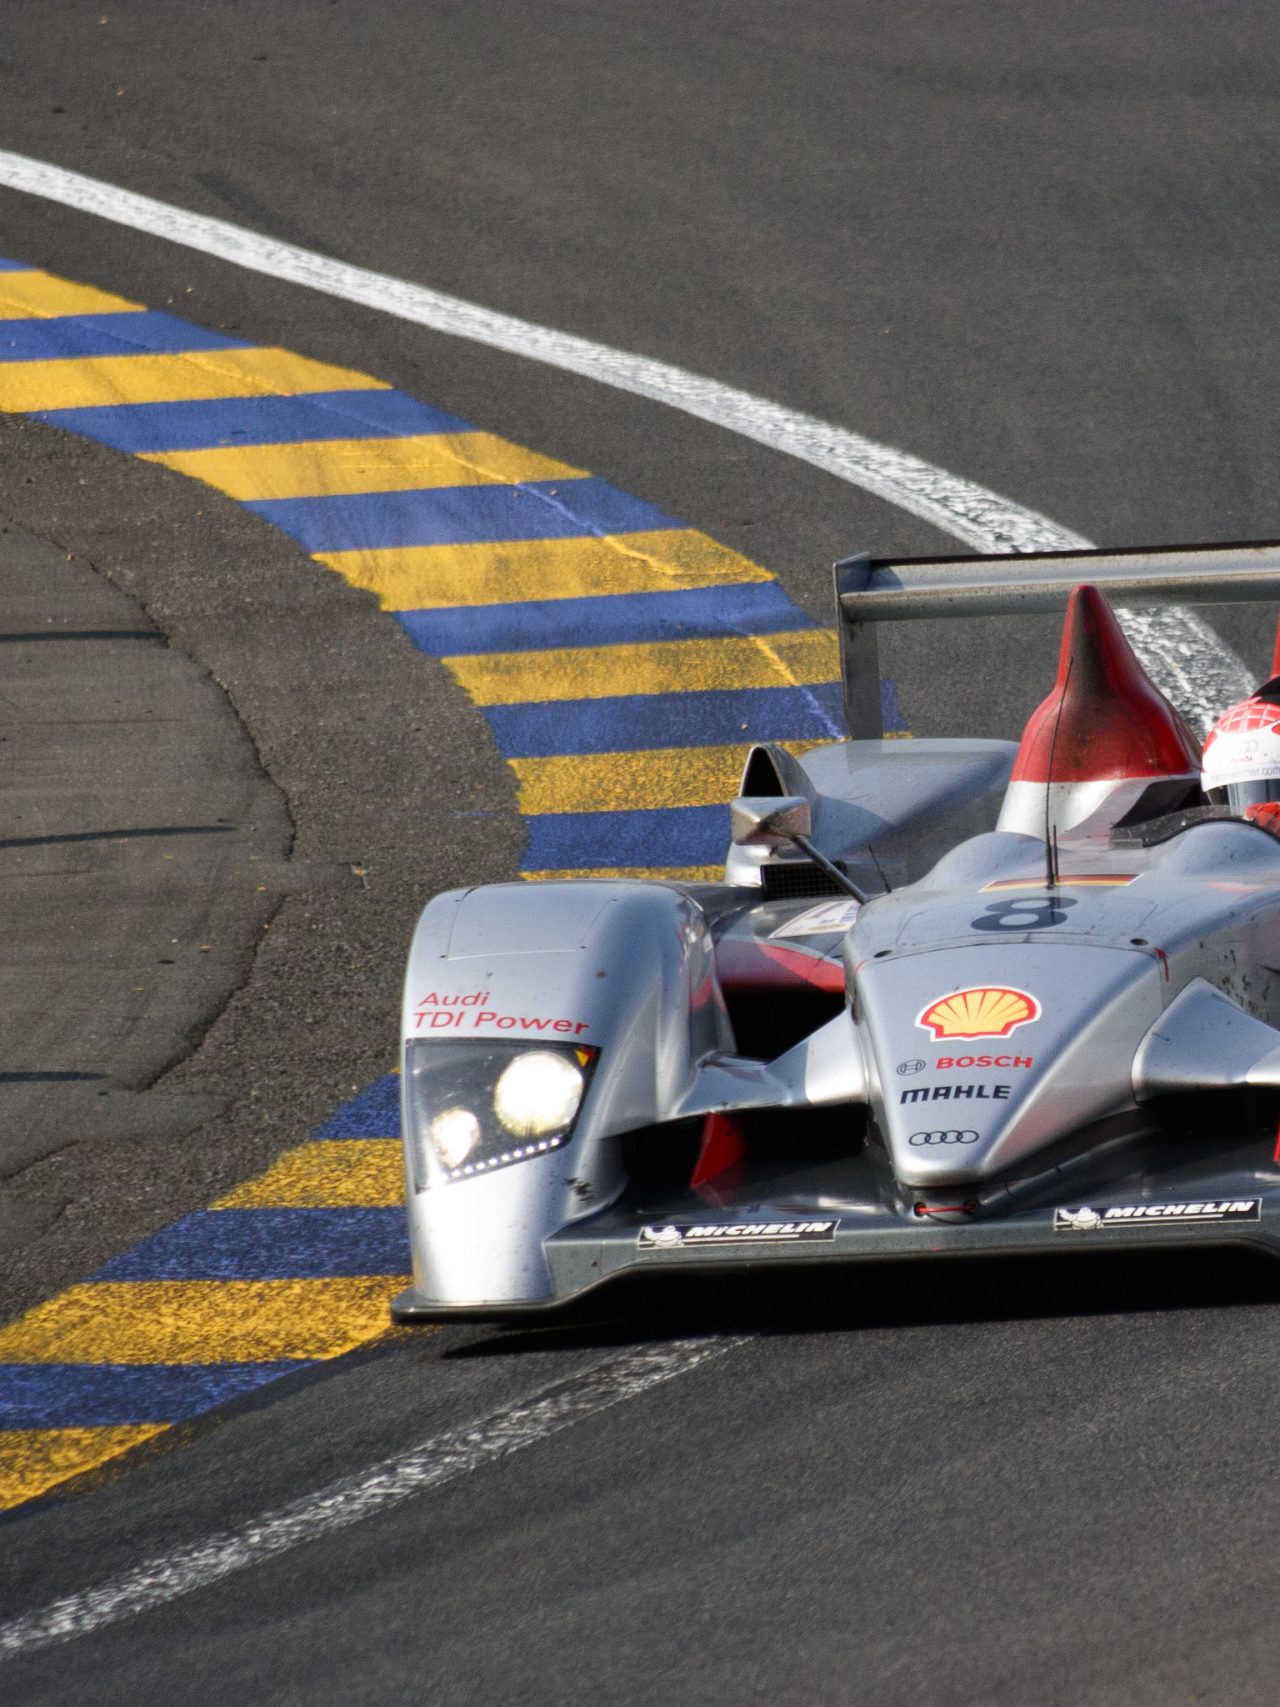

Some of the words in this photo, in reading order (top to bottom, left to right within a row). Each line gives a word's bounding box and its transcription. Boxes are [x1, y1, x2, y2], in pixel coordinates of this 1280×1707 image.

[970, 896, 1078, 931] 8
[418, 991, 491, 1006] Audi
[414, 1012, 465, 1028] TDI
[474, 1012, 590, 1035] Power
[936, 1055, 1033, 1069] BOSCH
[900, 1085, 1011, 1104] MAHLE
[1105, 1202, 1254, 1218] MICHELIN
[685, 1222, 832, 1237] MICHELIN
